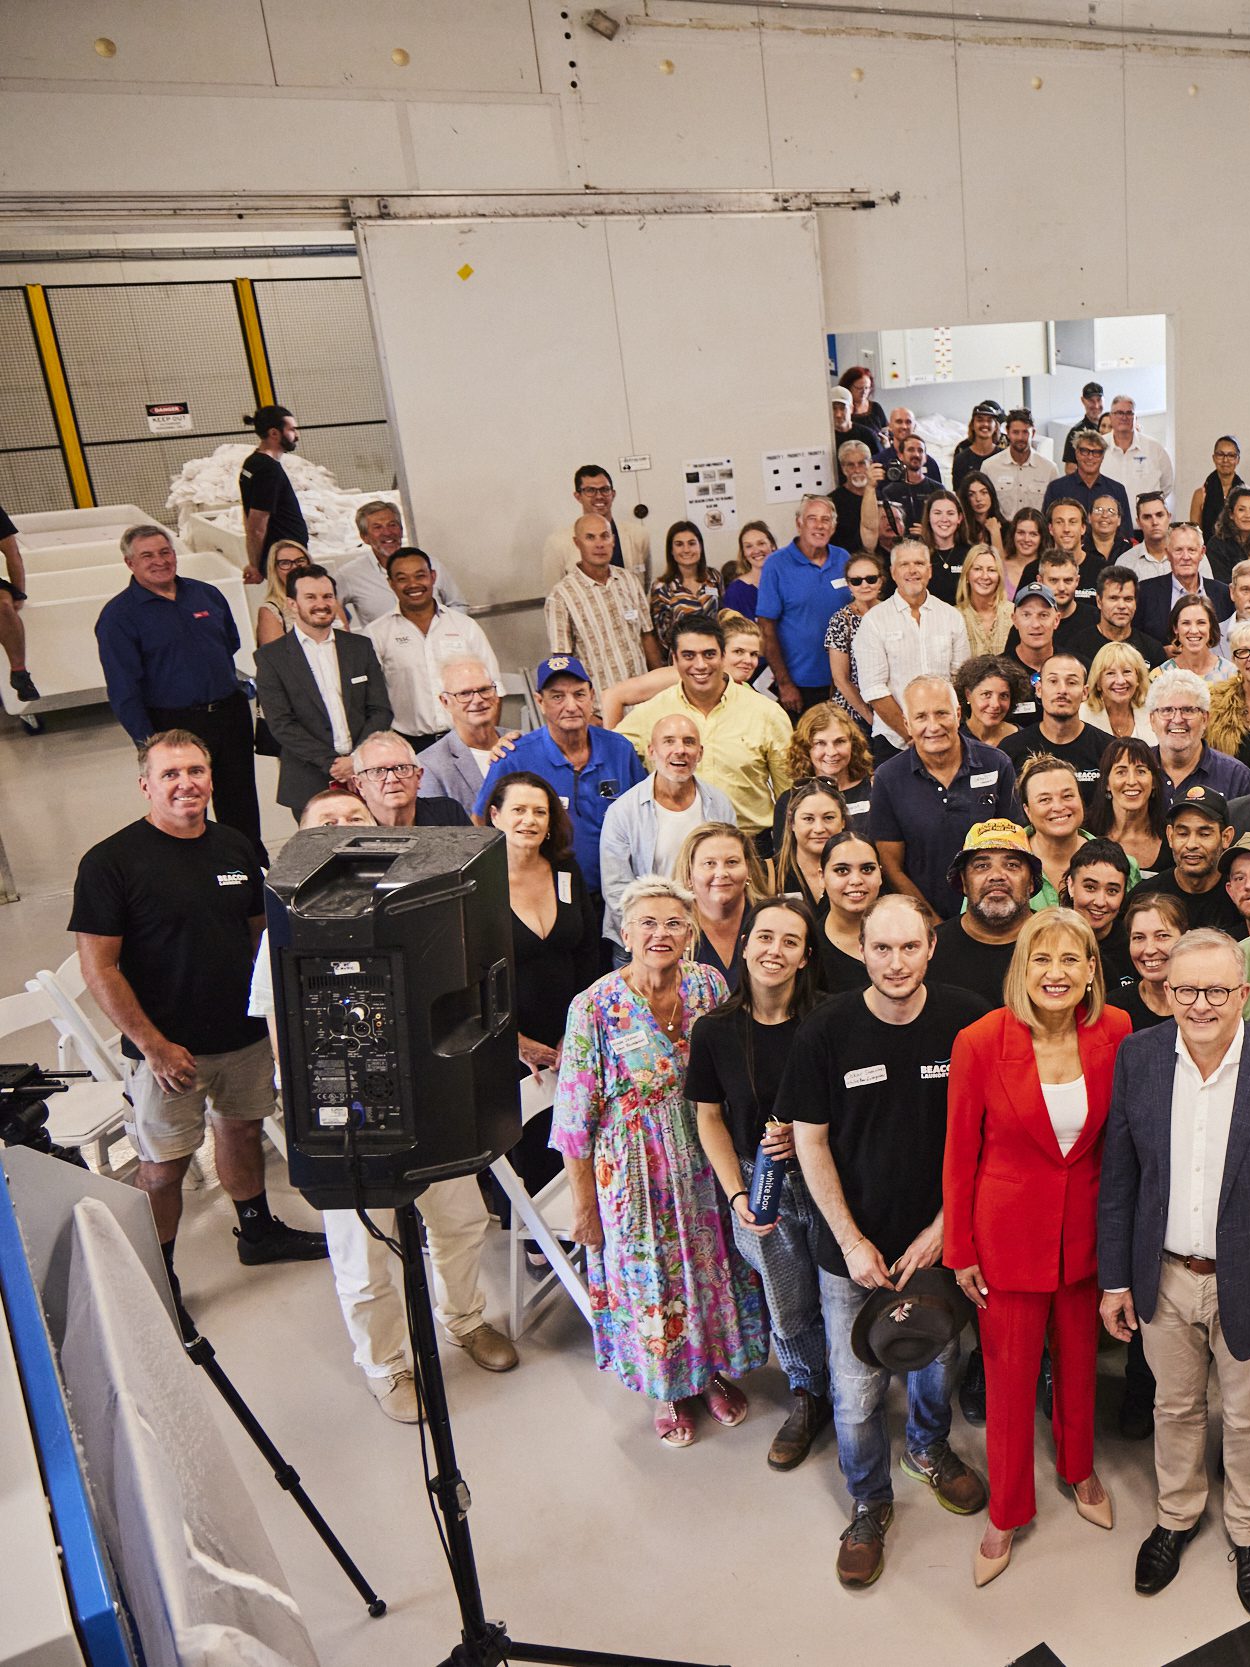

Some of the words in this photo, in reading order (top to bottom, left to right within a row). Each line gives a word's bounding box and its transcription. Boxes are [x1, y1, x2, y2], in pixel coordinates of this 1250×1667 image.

[153, 405, 180, 413] DANGER
[217, 874, 249, 883] BEACON
[920, 1064, 951, 1074] BEAC
[763, 1169, 775, 1194] white
[761, 1195, 772, 1211] box
